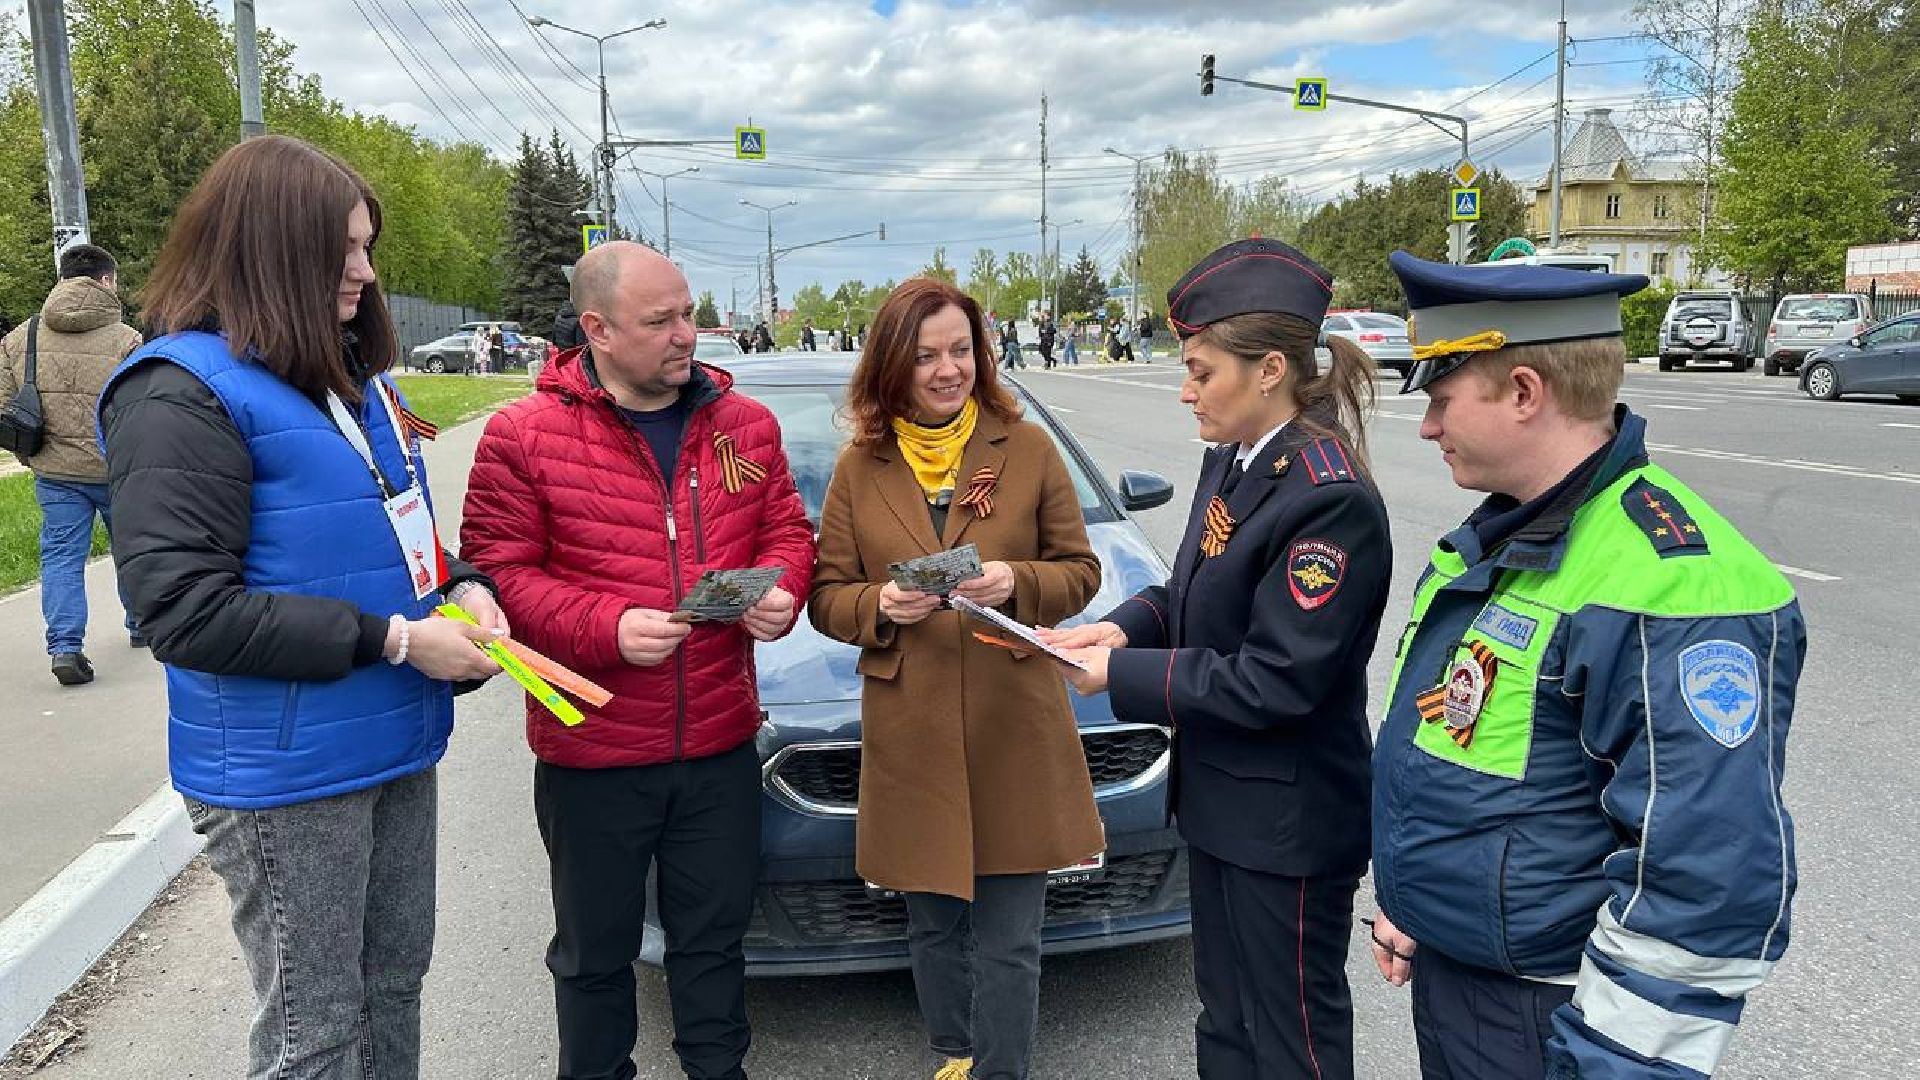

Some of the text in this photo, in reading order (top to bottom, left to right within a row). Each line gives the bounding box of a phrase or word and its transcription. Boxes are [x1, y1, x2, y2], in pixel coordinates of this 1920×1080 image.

[1295, 543, 1343, 562] ПОЛИЦИЯ
[1298, 554, 1336, 570] РОССИЯ
[1685, 647, 1755, 673] ПОЛИЦИЯ
[1695, 663, 1748, 681] РОССИЯ
